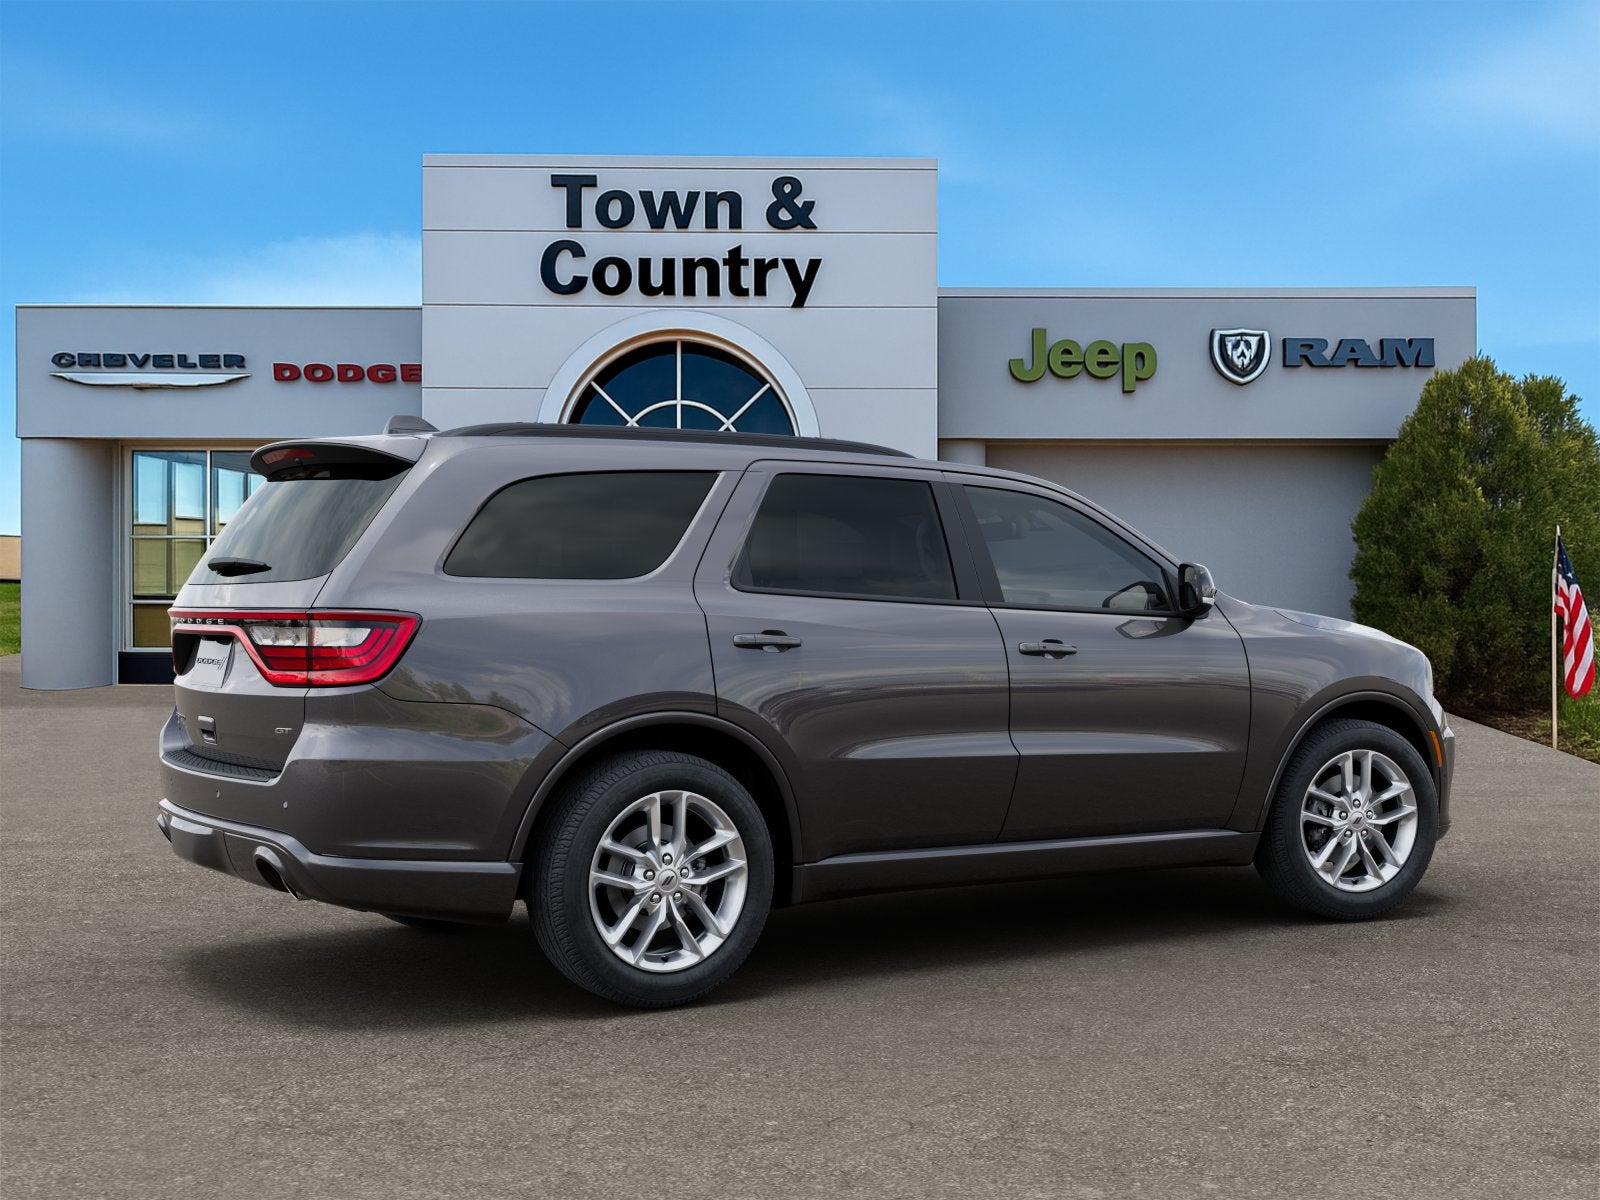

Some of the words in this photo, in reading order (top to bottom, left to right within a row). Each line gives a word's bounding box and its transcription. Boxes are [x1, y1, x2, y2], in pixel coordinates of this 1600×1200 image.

[550, 174, 743, 229] Town
[765, 175, 818, 230] &
[540, 239, 823, 308] Country
[273, 362, 422, 383] DODGE
[1008, 328, 1157, 392] Jeep
[1282, 337, 1436, 367] RAM
